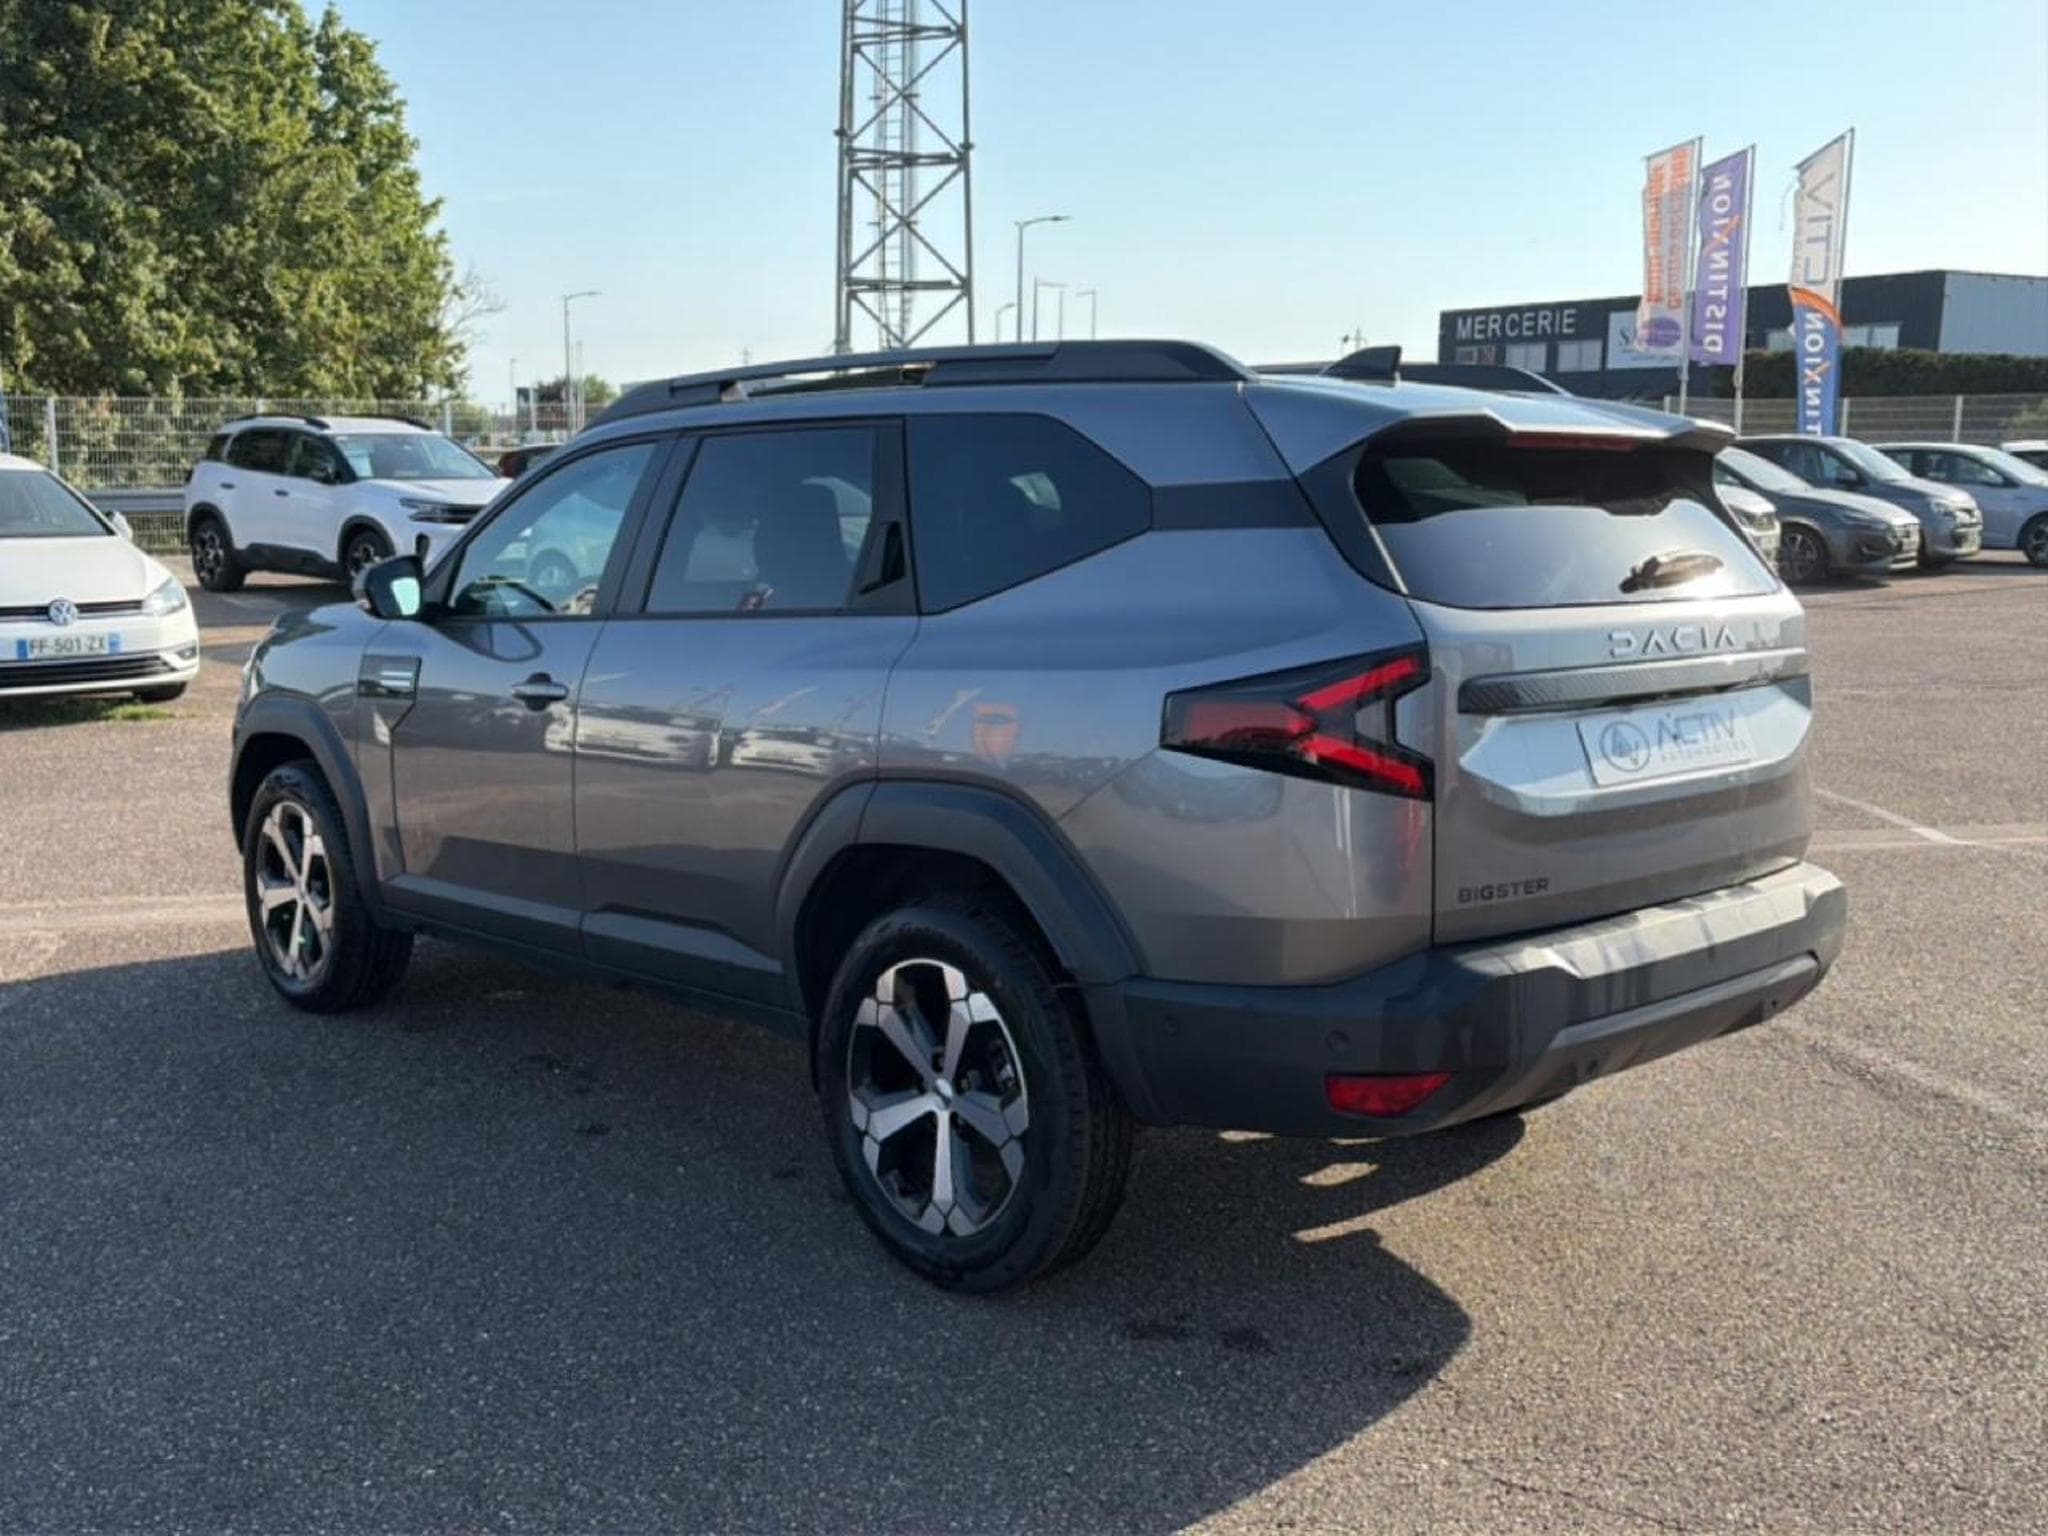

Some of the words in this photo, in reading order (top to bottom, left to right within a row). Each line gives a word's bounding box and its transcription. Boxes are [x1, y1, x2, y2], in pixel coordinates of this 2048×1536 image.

[1456, 308, 1577, 340] MERCERIE
[1608, 624, 1737, 658] DACIA
[1459, 878, 1550, 904] BIGSTER
